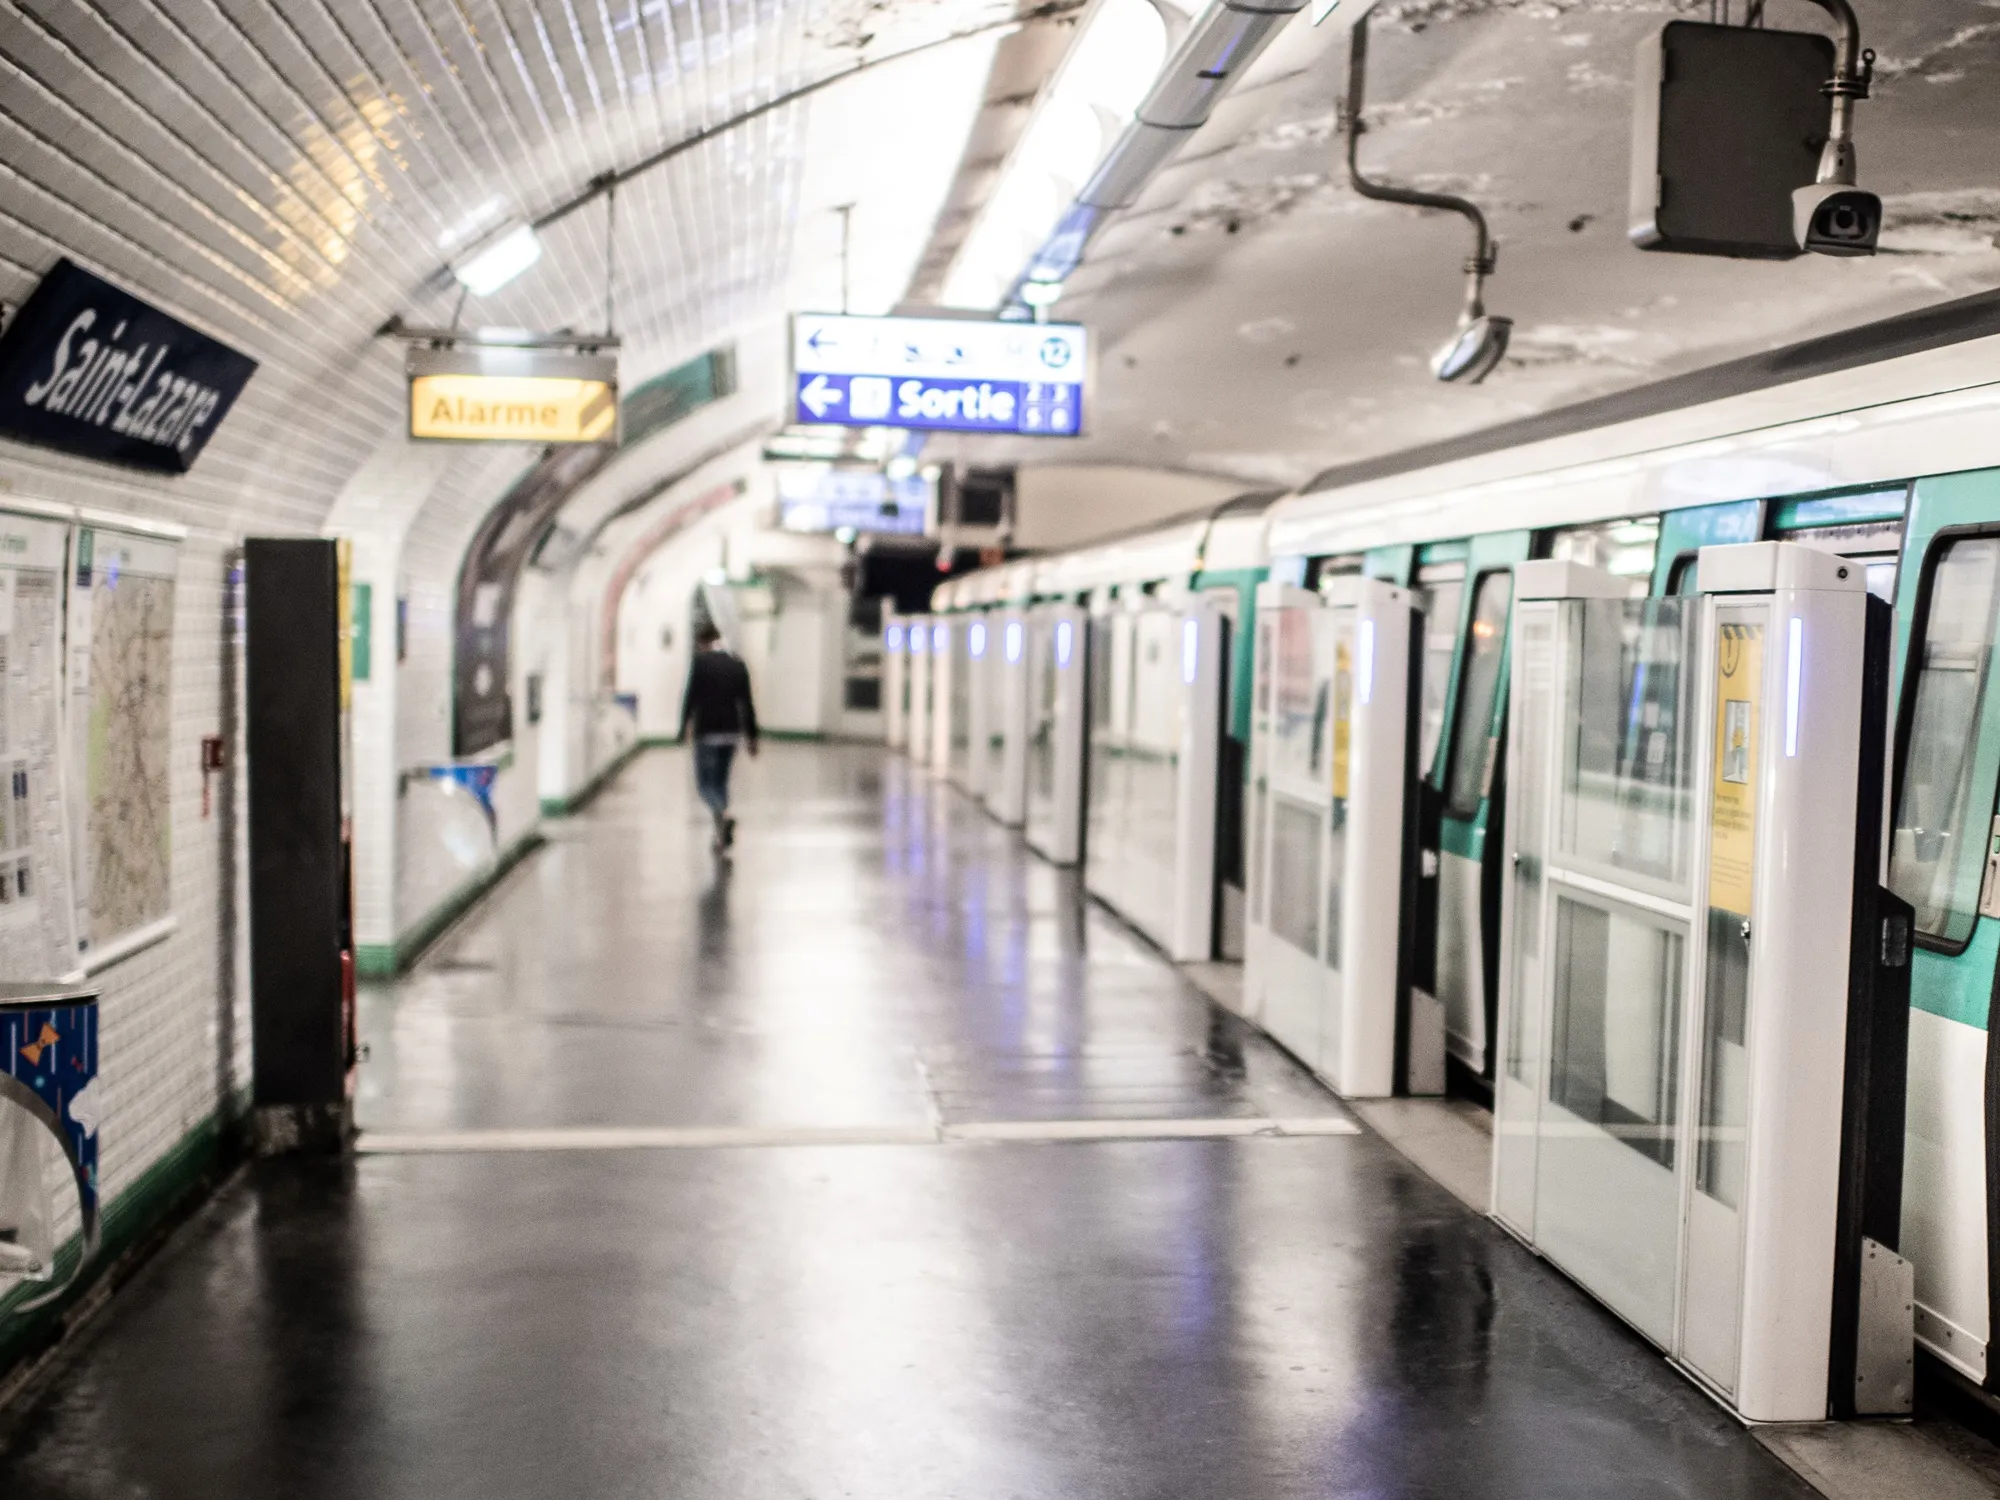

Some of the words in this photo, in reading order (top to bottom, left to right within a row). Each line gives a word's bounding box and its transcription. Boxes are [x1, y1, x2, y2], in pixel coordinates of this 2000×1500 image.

[25, 308, 220, 451] Saint-Lazare
[430, 396, 560, 428] Alarme
[898, 380, 1016, 422] Sortie
